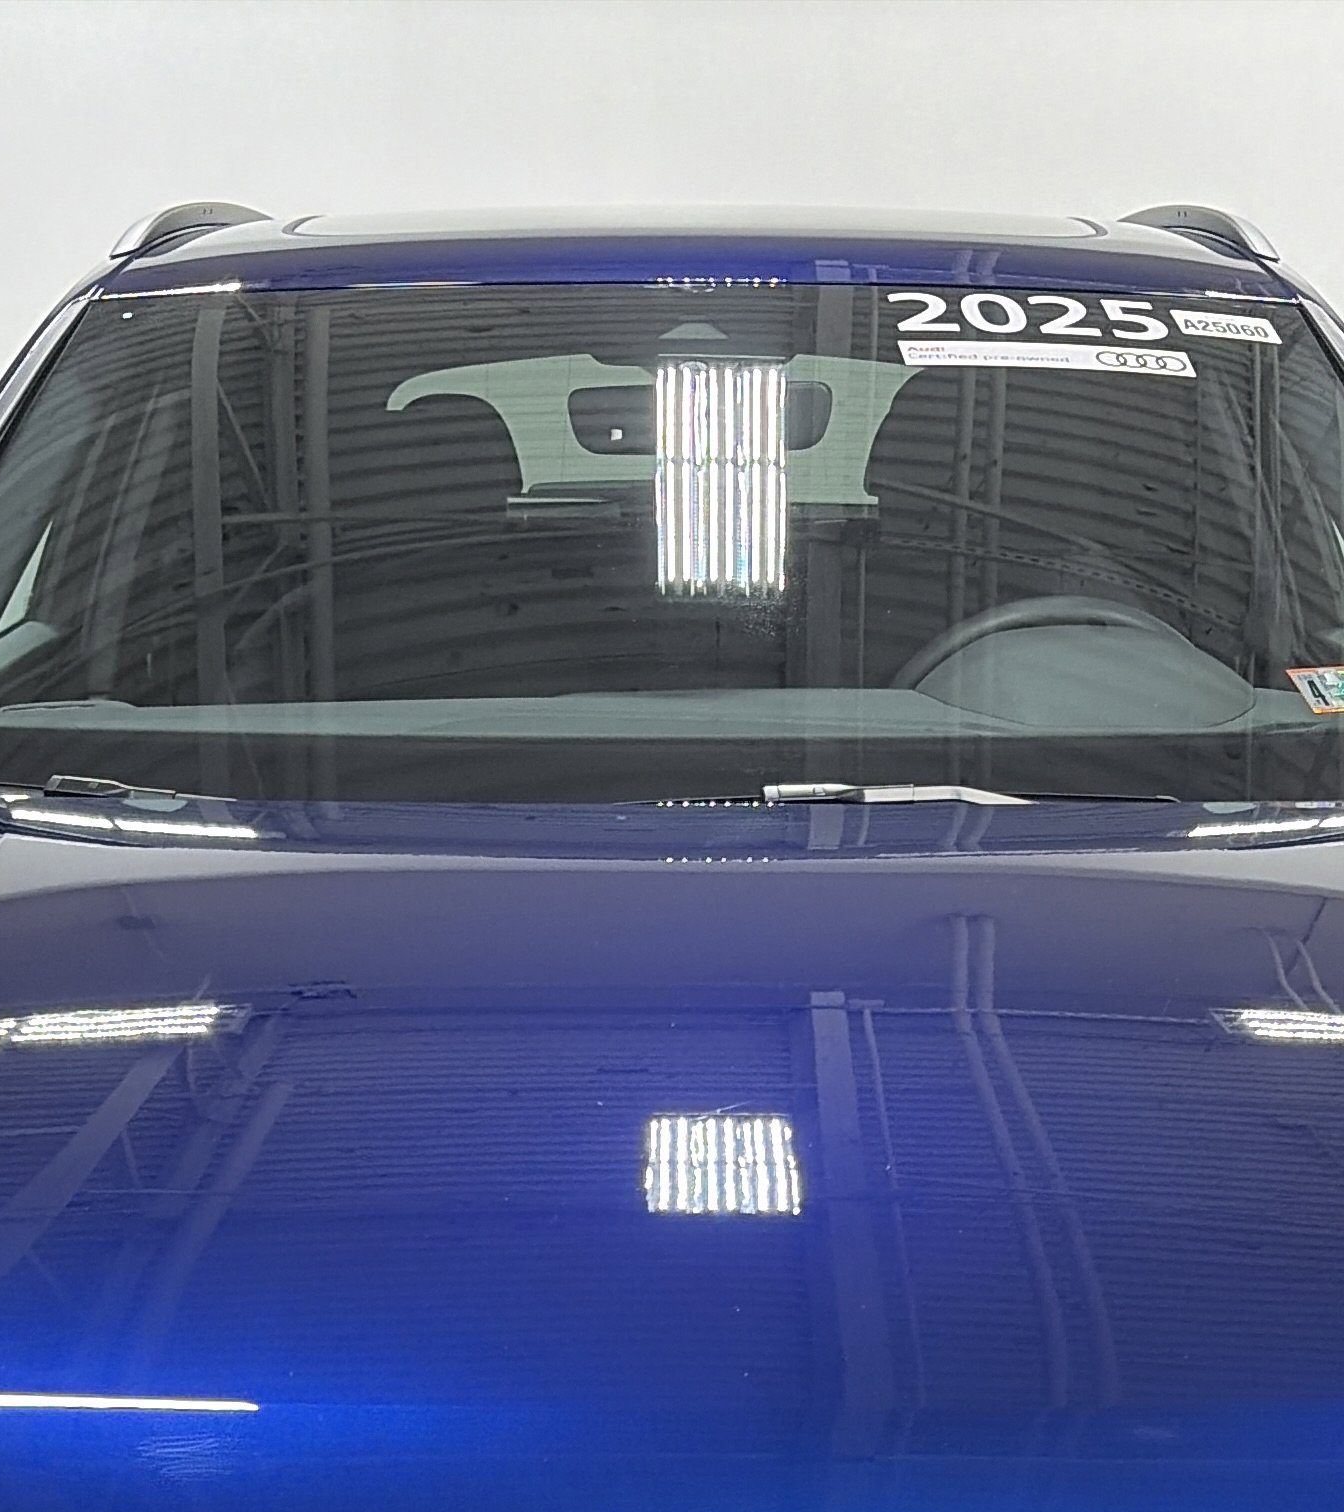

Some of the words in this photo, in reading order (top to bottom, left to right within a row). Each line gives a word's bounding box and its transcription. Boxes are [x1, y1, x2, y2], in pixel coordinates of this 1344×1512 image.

[887, 292, 1169, 341] 2025
[1184, 318, 1269, 339] A25060
[908, 352, 978, 360] Certified
[1308, 679, 1330, 706] 4
